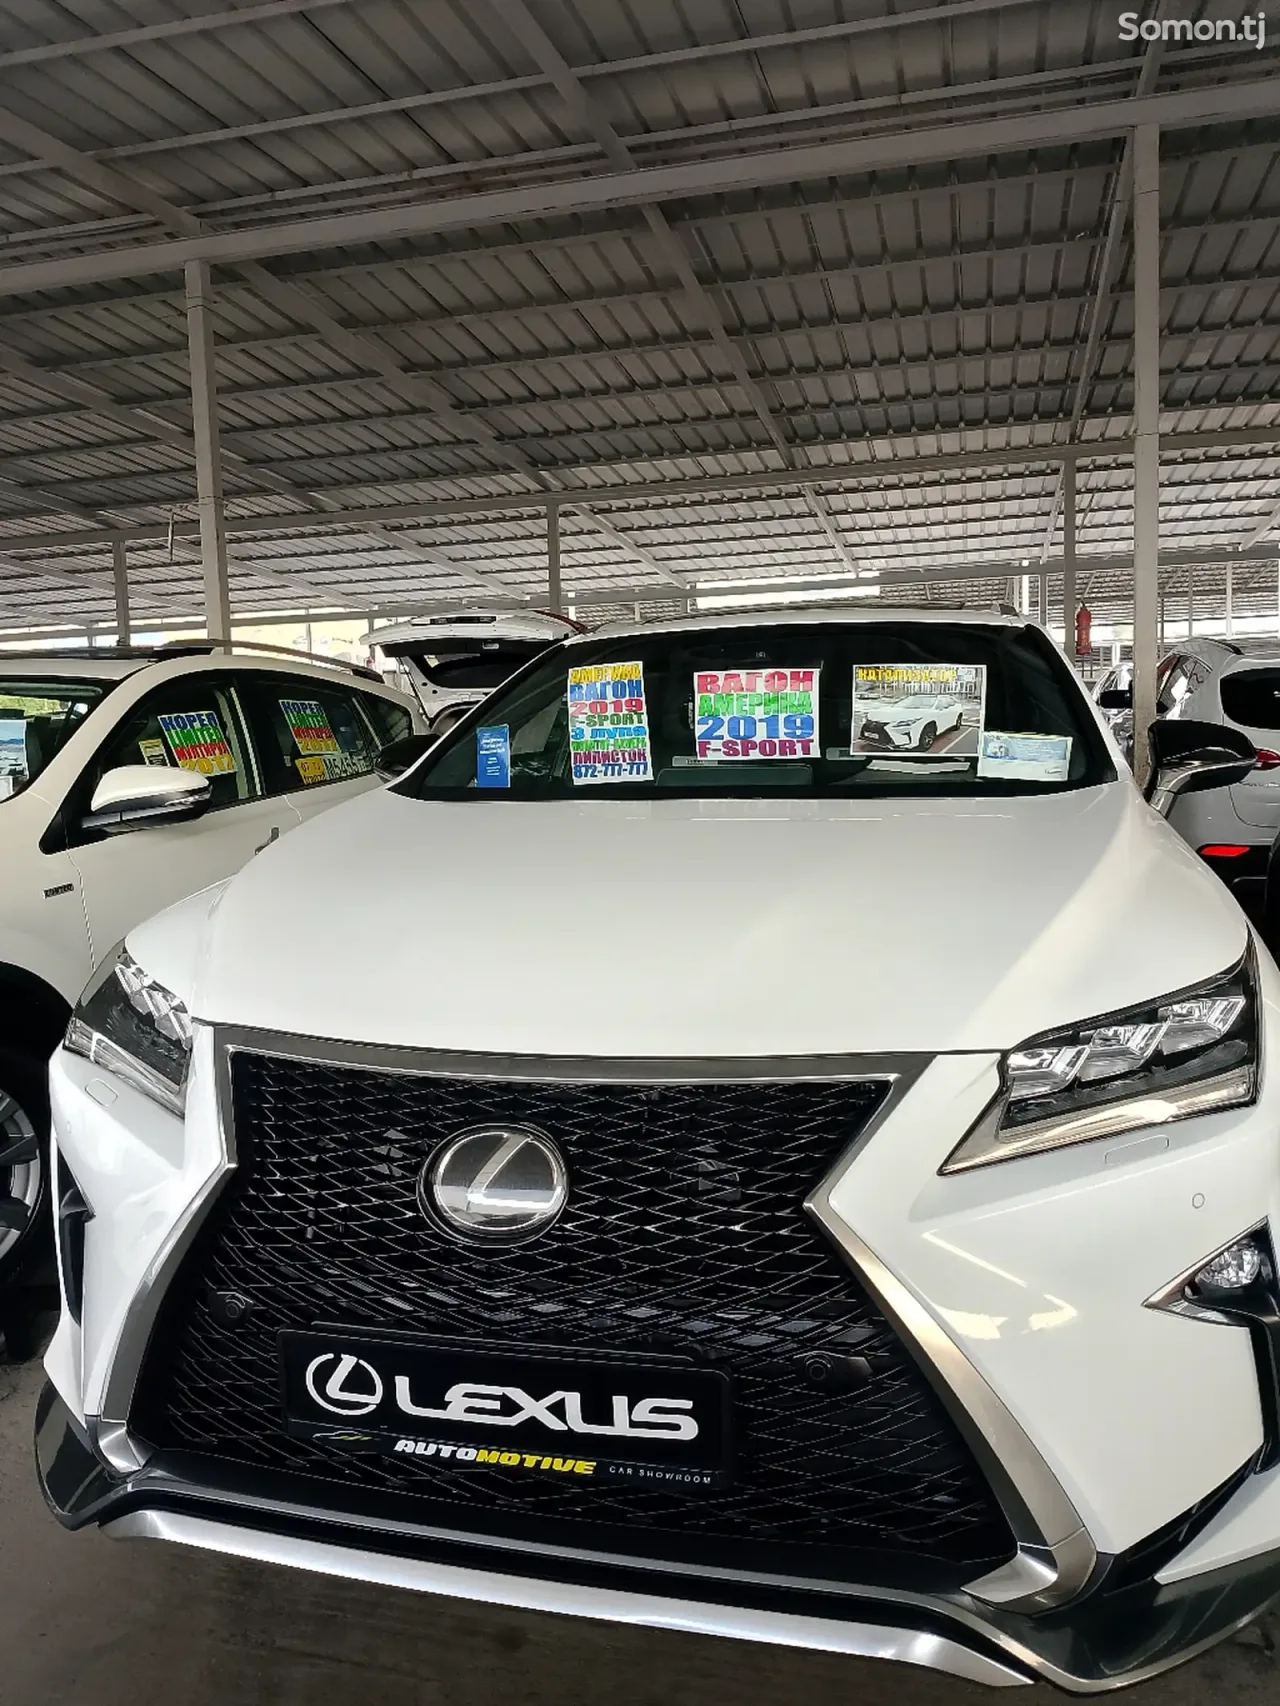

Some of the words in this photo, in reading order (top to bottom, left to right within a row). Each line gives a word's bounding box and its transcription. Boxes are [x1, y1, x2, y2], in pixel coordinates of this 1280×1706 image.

[569, 680, 643, 702] ВАГОН
[697, 671, 814, 693] ВАГОН
[569, 699, 643, 716] 2019
[698, 691, 813, 716] АМЕРИКА
[570, 712, 644, 727] F-SPORT
[697, 714, 814, 740] 2019
[698, 739, 814, 757] F-SPORT
[394, 1375, 699, 1440] LEXUS
[394, 1439, 597, 1475] AUTOMOTIVE
[609, 1465, 633, 1476] CAR
[639, 1468, 712, 1485] SHOWROOM
